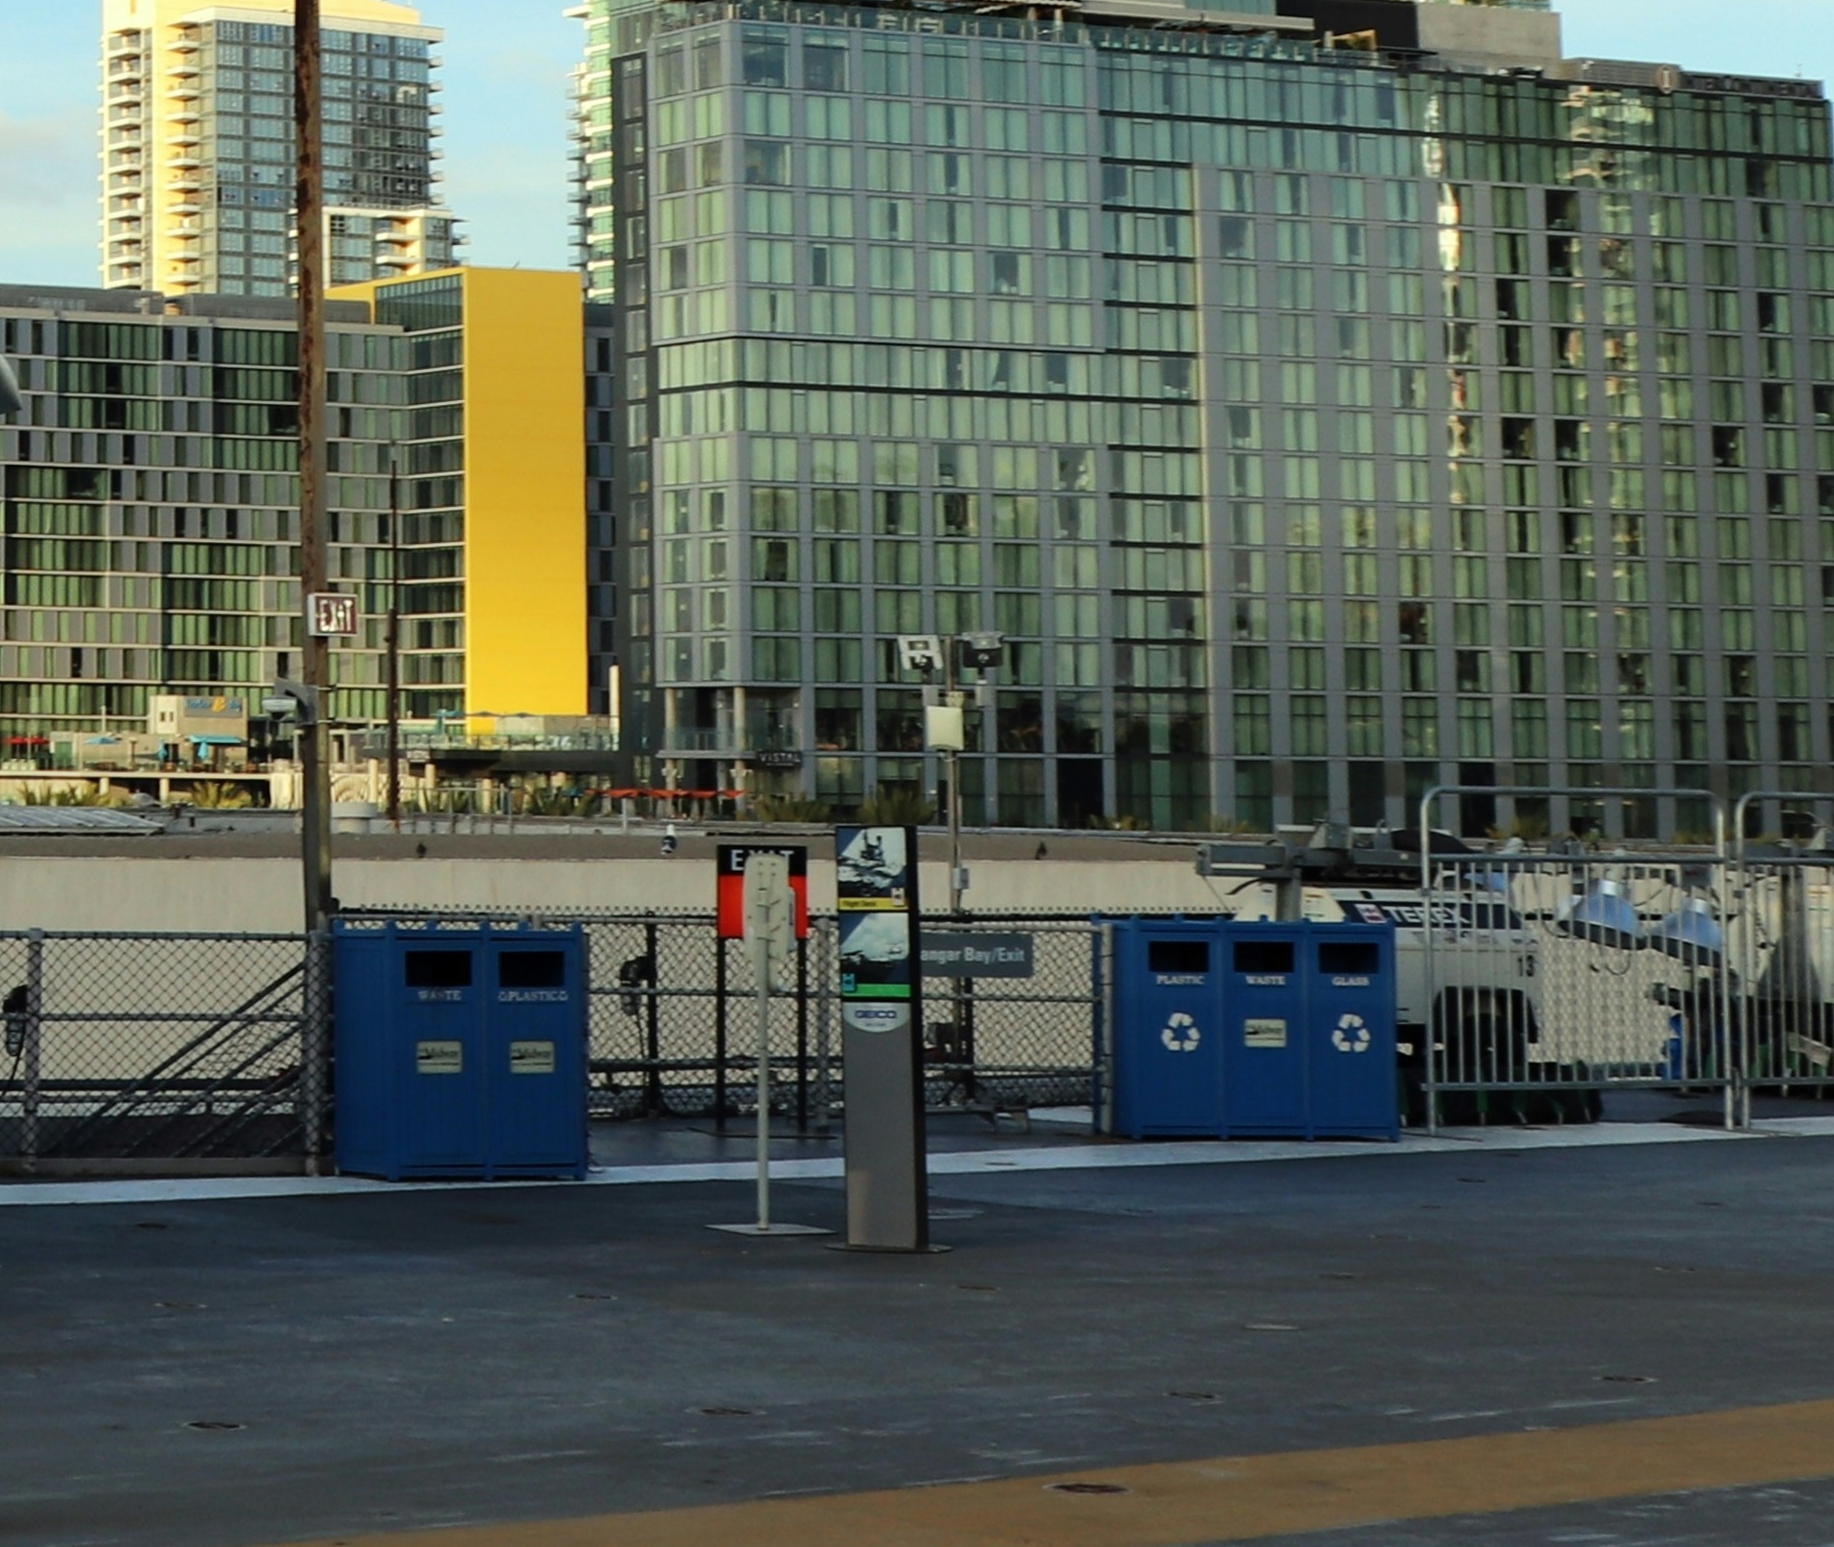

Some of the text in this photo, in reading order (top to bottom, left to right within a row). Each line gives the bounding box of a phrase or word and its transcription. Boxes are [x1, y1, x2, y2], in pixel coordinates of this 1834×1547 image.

[319, 599, 354, 632] EXIT
[758, 752, 801, 763] VISTAL
[730, 849, 795, 872] ET
[920, 946, 1025, 965] angar Bay/Exit
[1517, 954, 1535, 977] 13
[1156, 975, 1205, 986] PLASTIC
[1245, 975, 1286, 986] WASTE
[1331, 977, 1370, 987] GLASS
[417, 990, 462, 1001] WASTE
[508, 990, 558, 1001] PLASTIC
